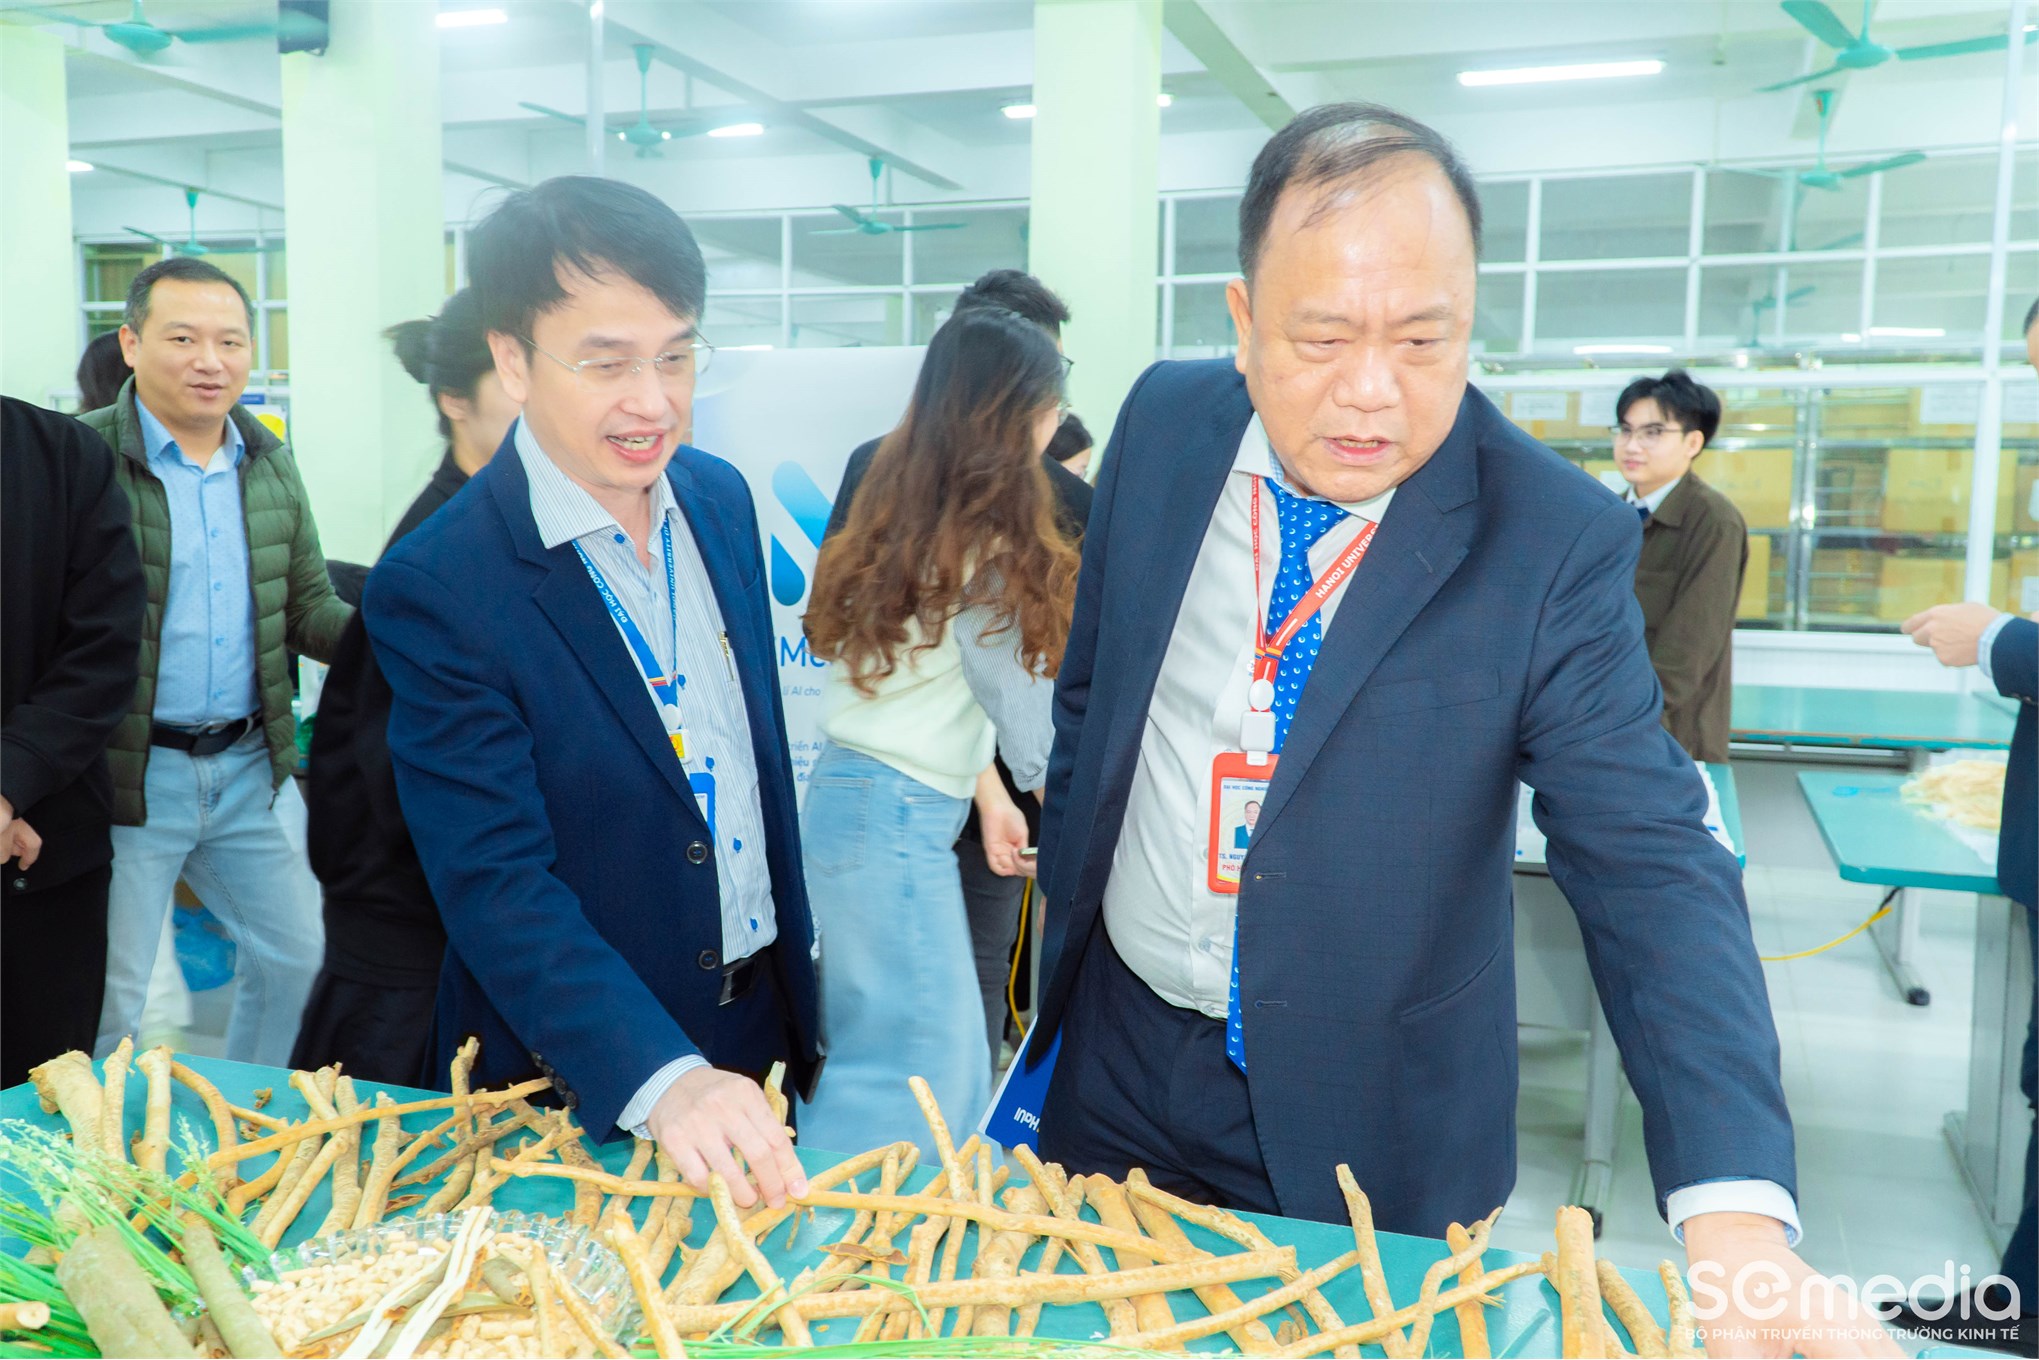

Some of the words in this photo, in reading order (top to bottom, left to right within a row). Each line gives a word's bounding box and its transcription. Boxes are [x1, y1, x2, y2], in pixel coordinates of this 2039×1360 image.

[1315, 566, 1345, 599] HANOI
[601, 588, 617, 607] HỌC
[1013, 1107, 1040, 1131] HaUI
